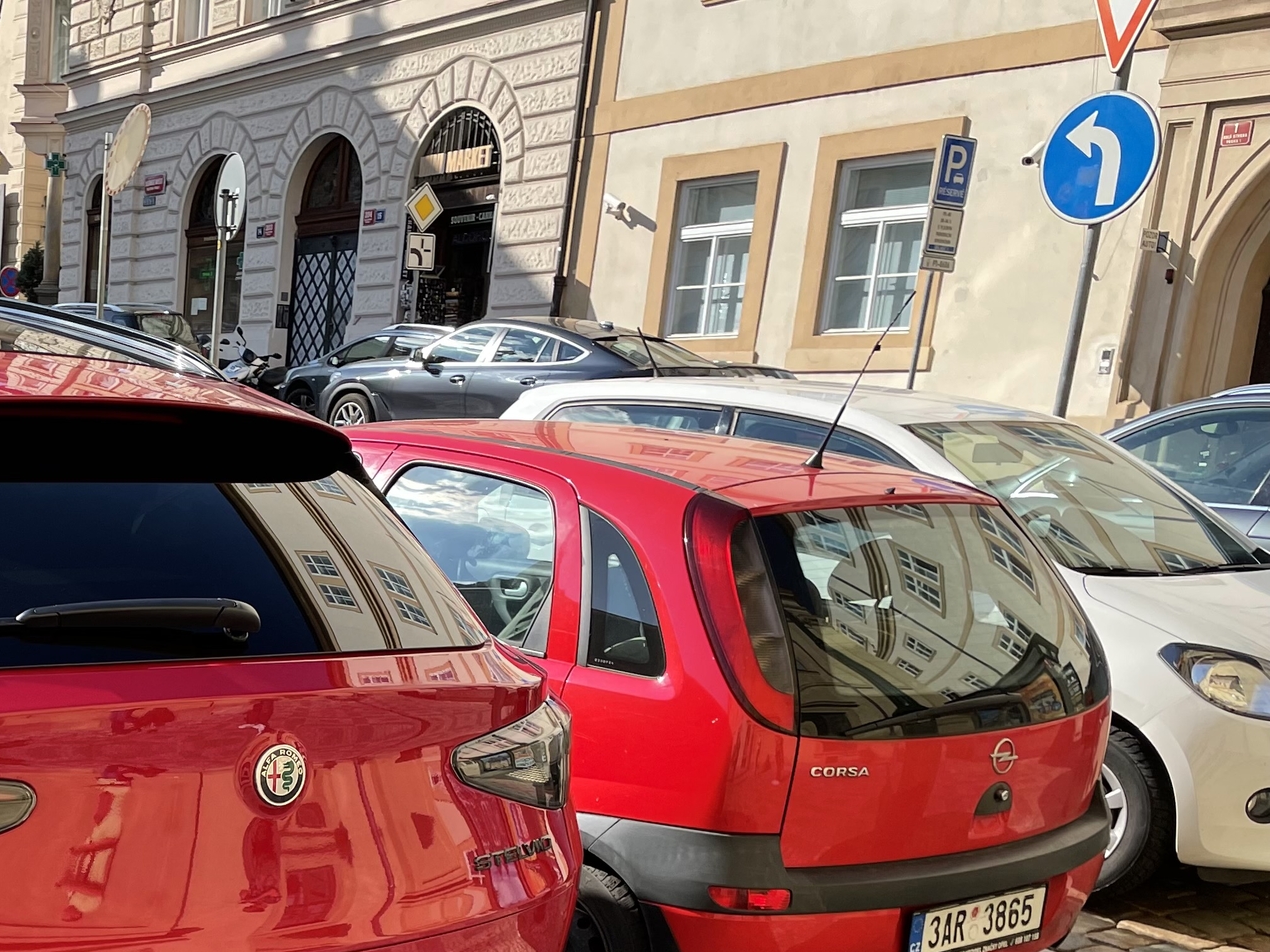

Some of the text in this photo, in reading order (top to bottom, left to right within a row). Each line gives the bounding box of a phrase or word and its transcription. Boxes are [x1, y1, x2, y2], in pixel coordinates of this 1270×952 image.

[445, 145, 493, 173] MARKET
[944, 144, 968, 183] P
[938, 184, 965, 199] RÉSERVÉ
[261, 748, 304, 778] ALFA ROMEO
[810, 766, 870, 778] CORSA
[473, 836, 552, 872] STELVIO
[927, 893, 1035, 949] 3AR 3865
